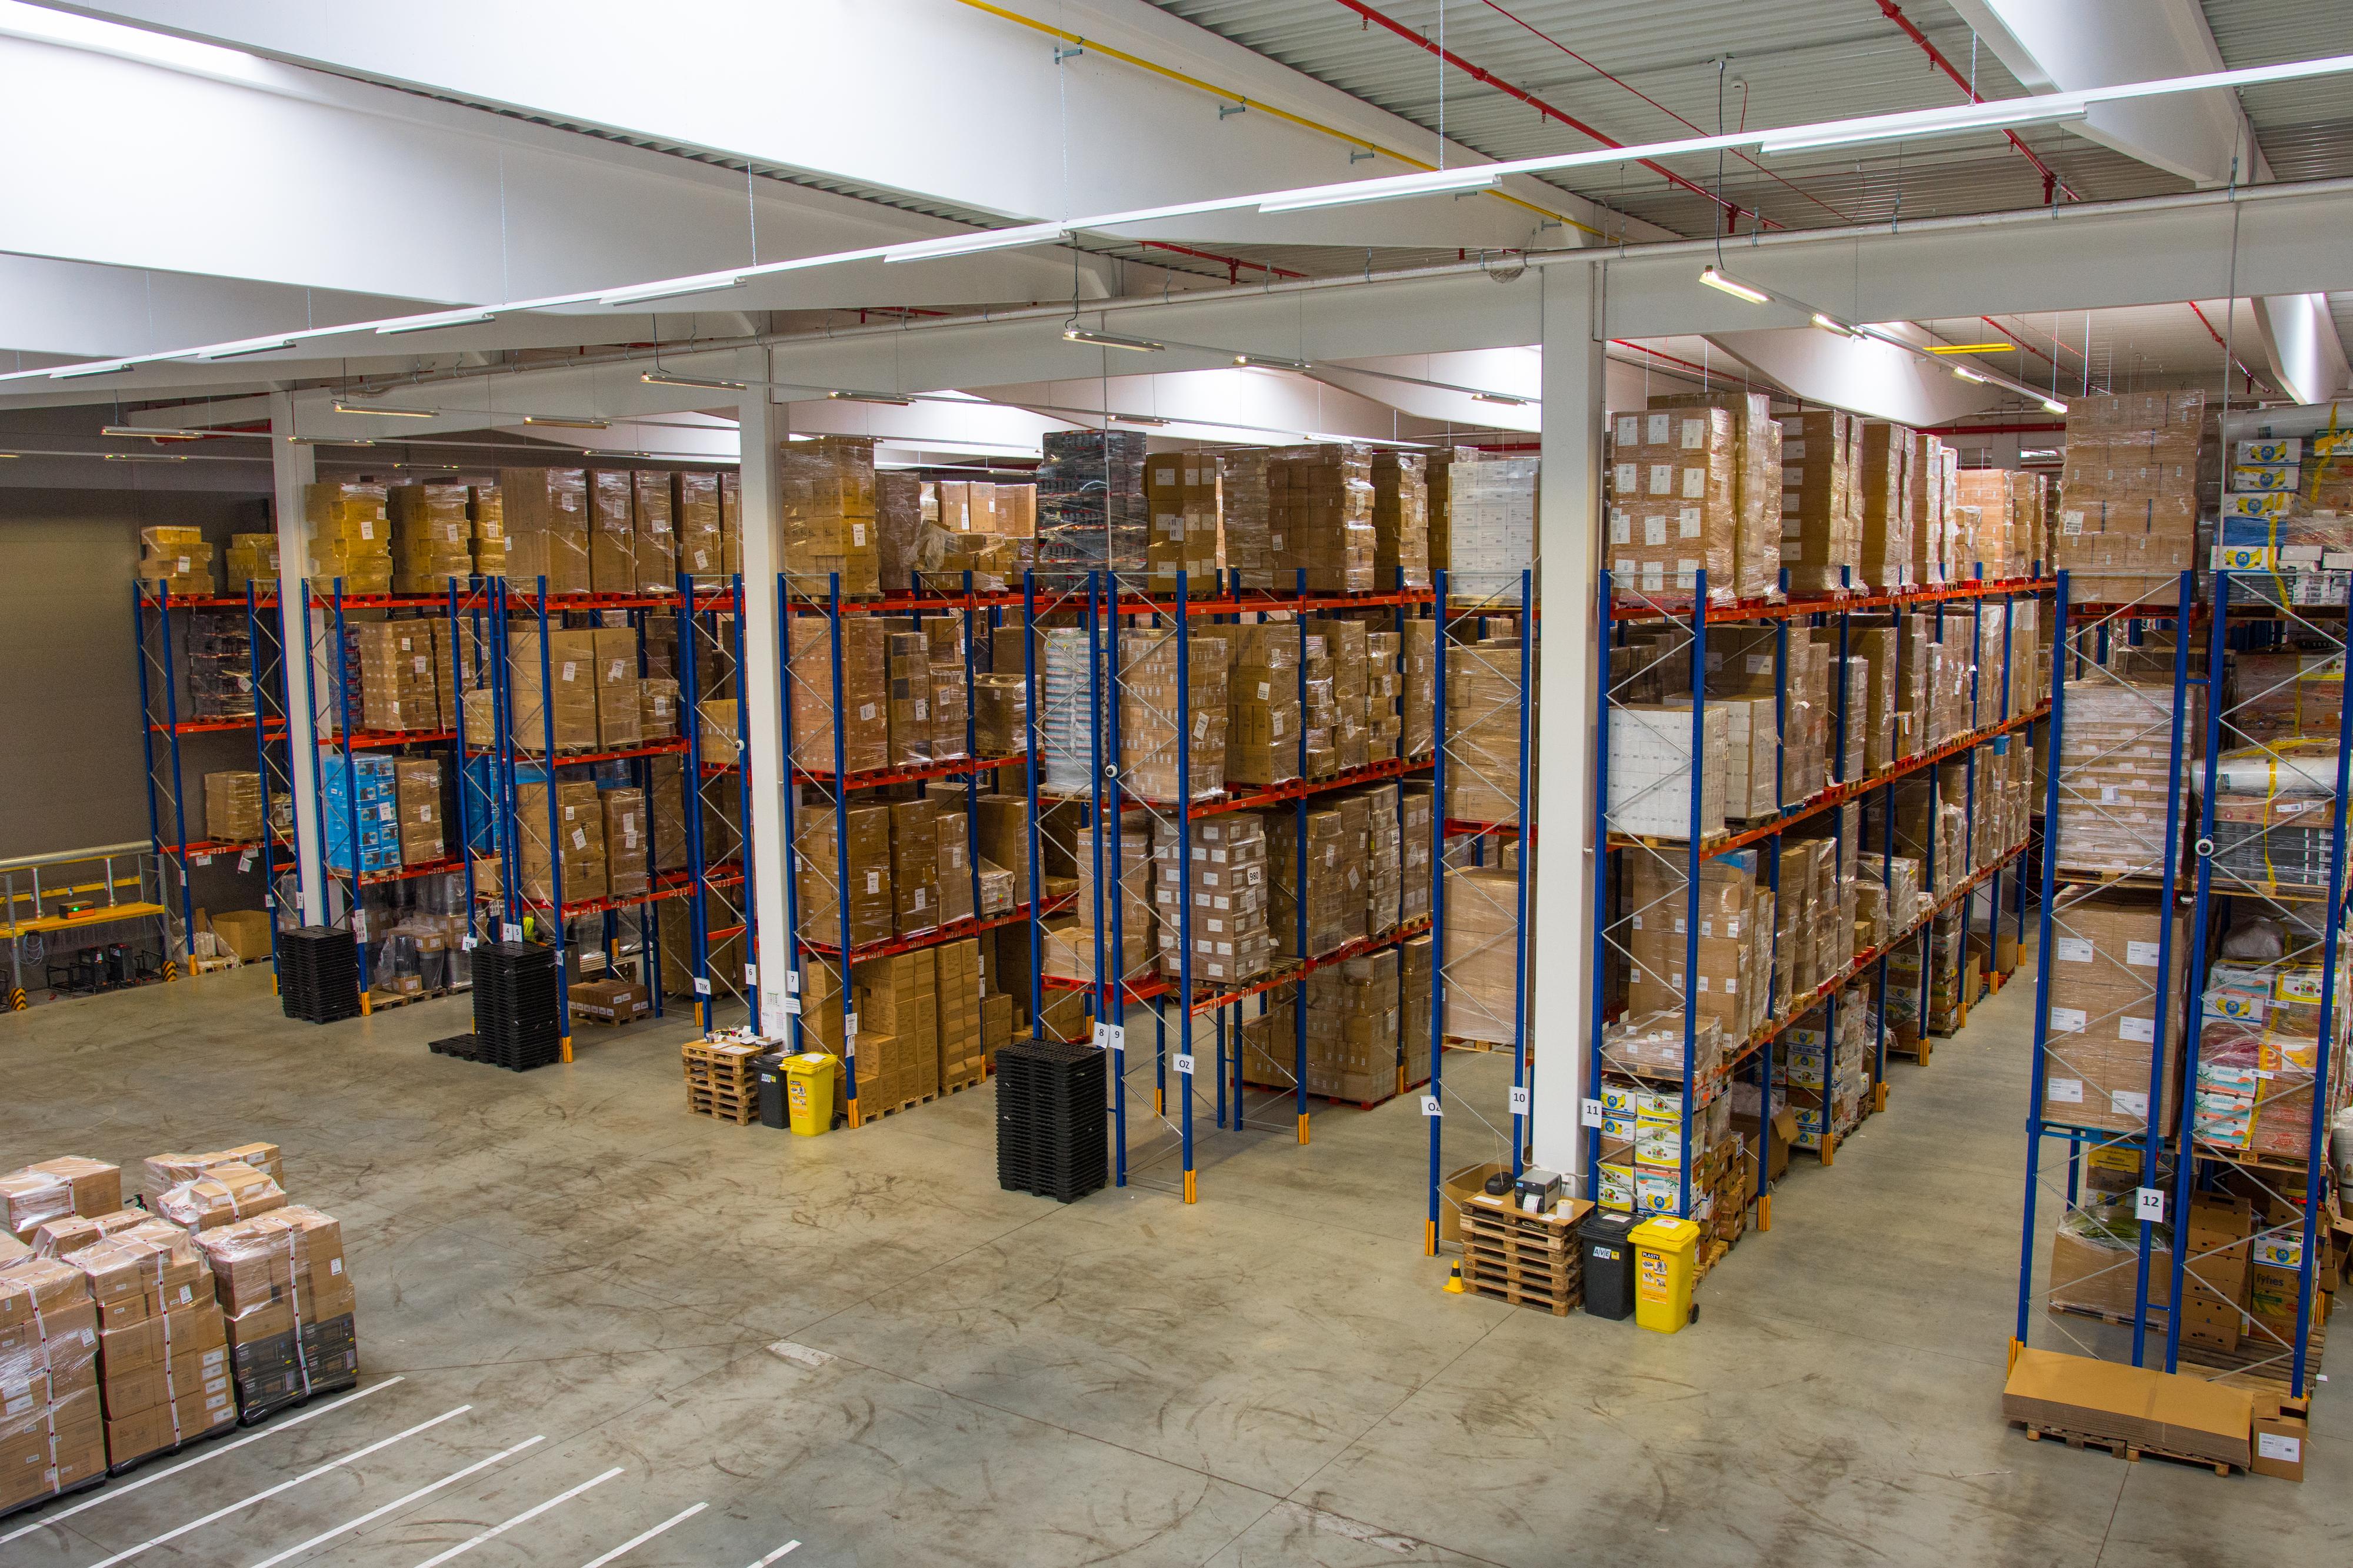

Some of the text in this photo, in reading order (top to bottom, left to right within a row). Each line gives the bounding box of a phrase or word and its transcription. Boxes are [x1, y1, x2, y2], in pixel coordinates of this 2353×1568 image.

[1249, 872, 1259, 880] 980
[699, 983, 708, 991] TIK
[1179, 1060, 1189, 1069] OZ
[1513, 1093, 1525, 1102] 10
[1587, 1105, 1598, 1115] 11
[2142, 1195, 2159, 1207] 12
[1594, 1249, 1610, 1257] AVE
